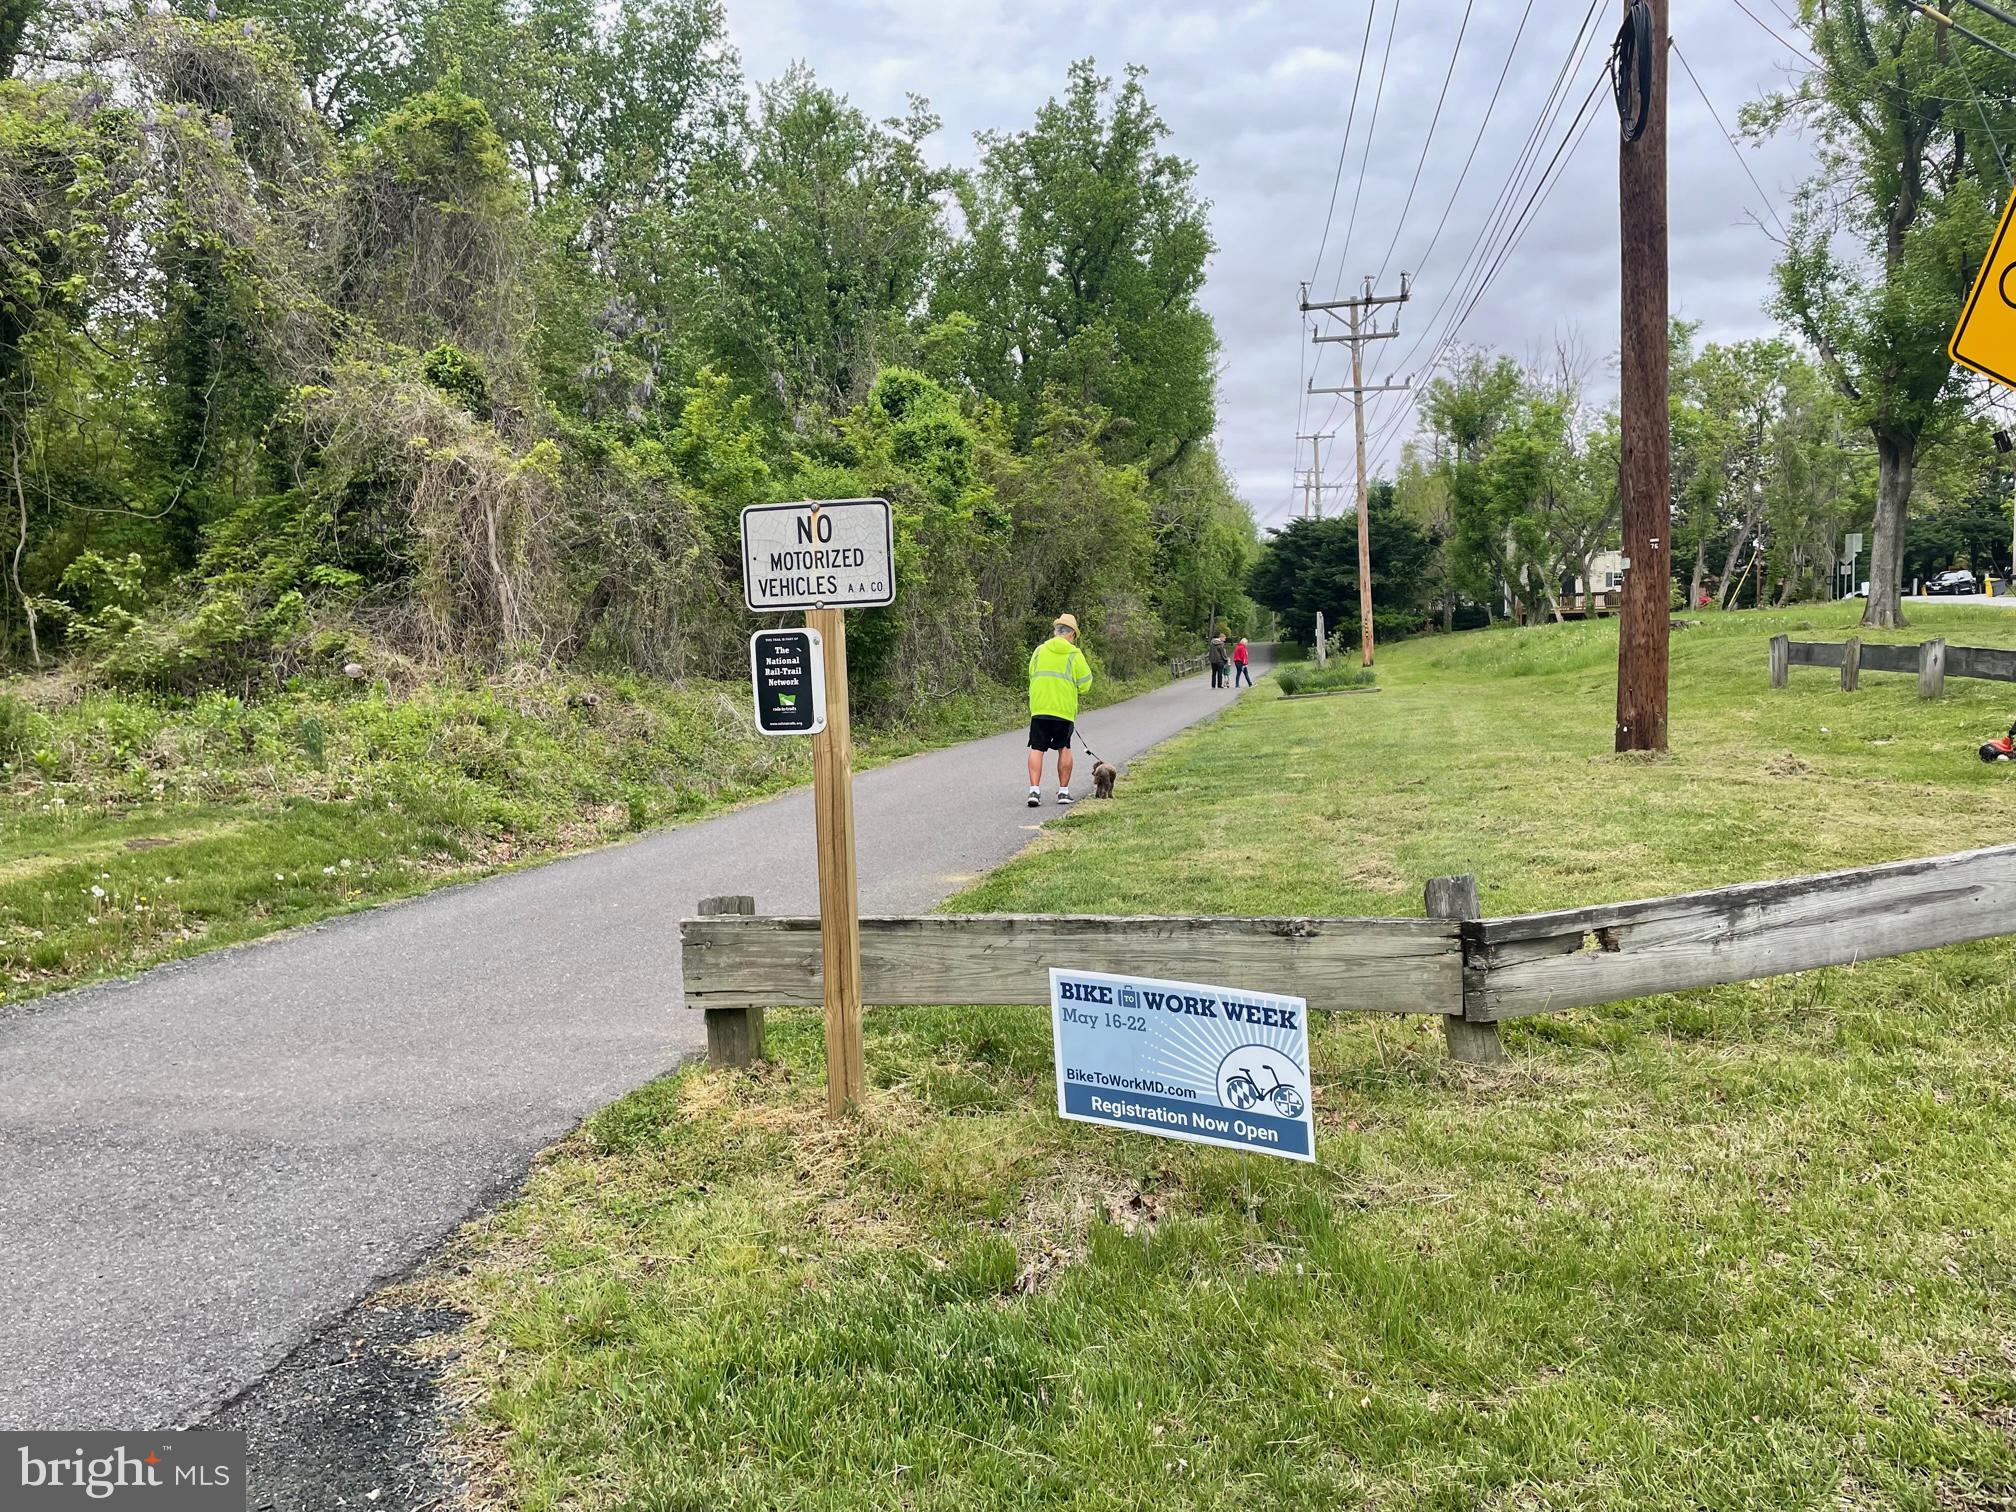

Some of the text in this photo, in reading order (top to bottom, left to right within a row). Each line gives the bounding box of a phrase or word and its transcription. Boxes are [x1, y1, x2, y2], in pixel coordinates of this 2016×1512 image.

[797, 514, 832, 544] NO
[770, 548, 864, 572] MOTORIZED
[758, 575, 838, 598] VEHICLES
[765, 656, 800, 665] National
[774, 646, 790, 654] The
[764, 667, 802, 676] Rail-Trail
[768, 677, 800, 687] Network
[1060, 982, 1298, 1030] BIKE TO WORK WEEK
[1061, 1007, 1147, 1032] May 16-22
[1066, 1068, 1197, 1099] BikeToWorkMD.com
[1091, 1095, 1279, 1142] Registration Now Open
